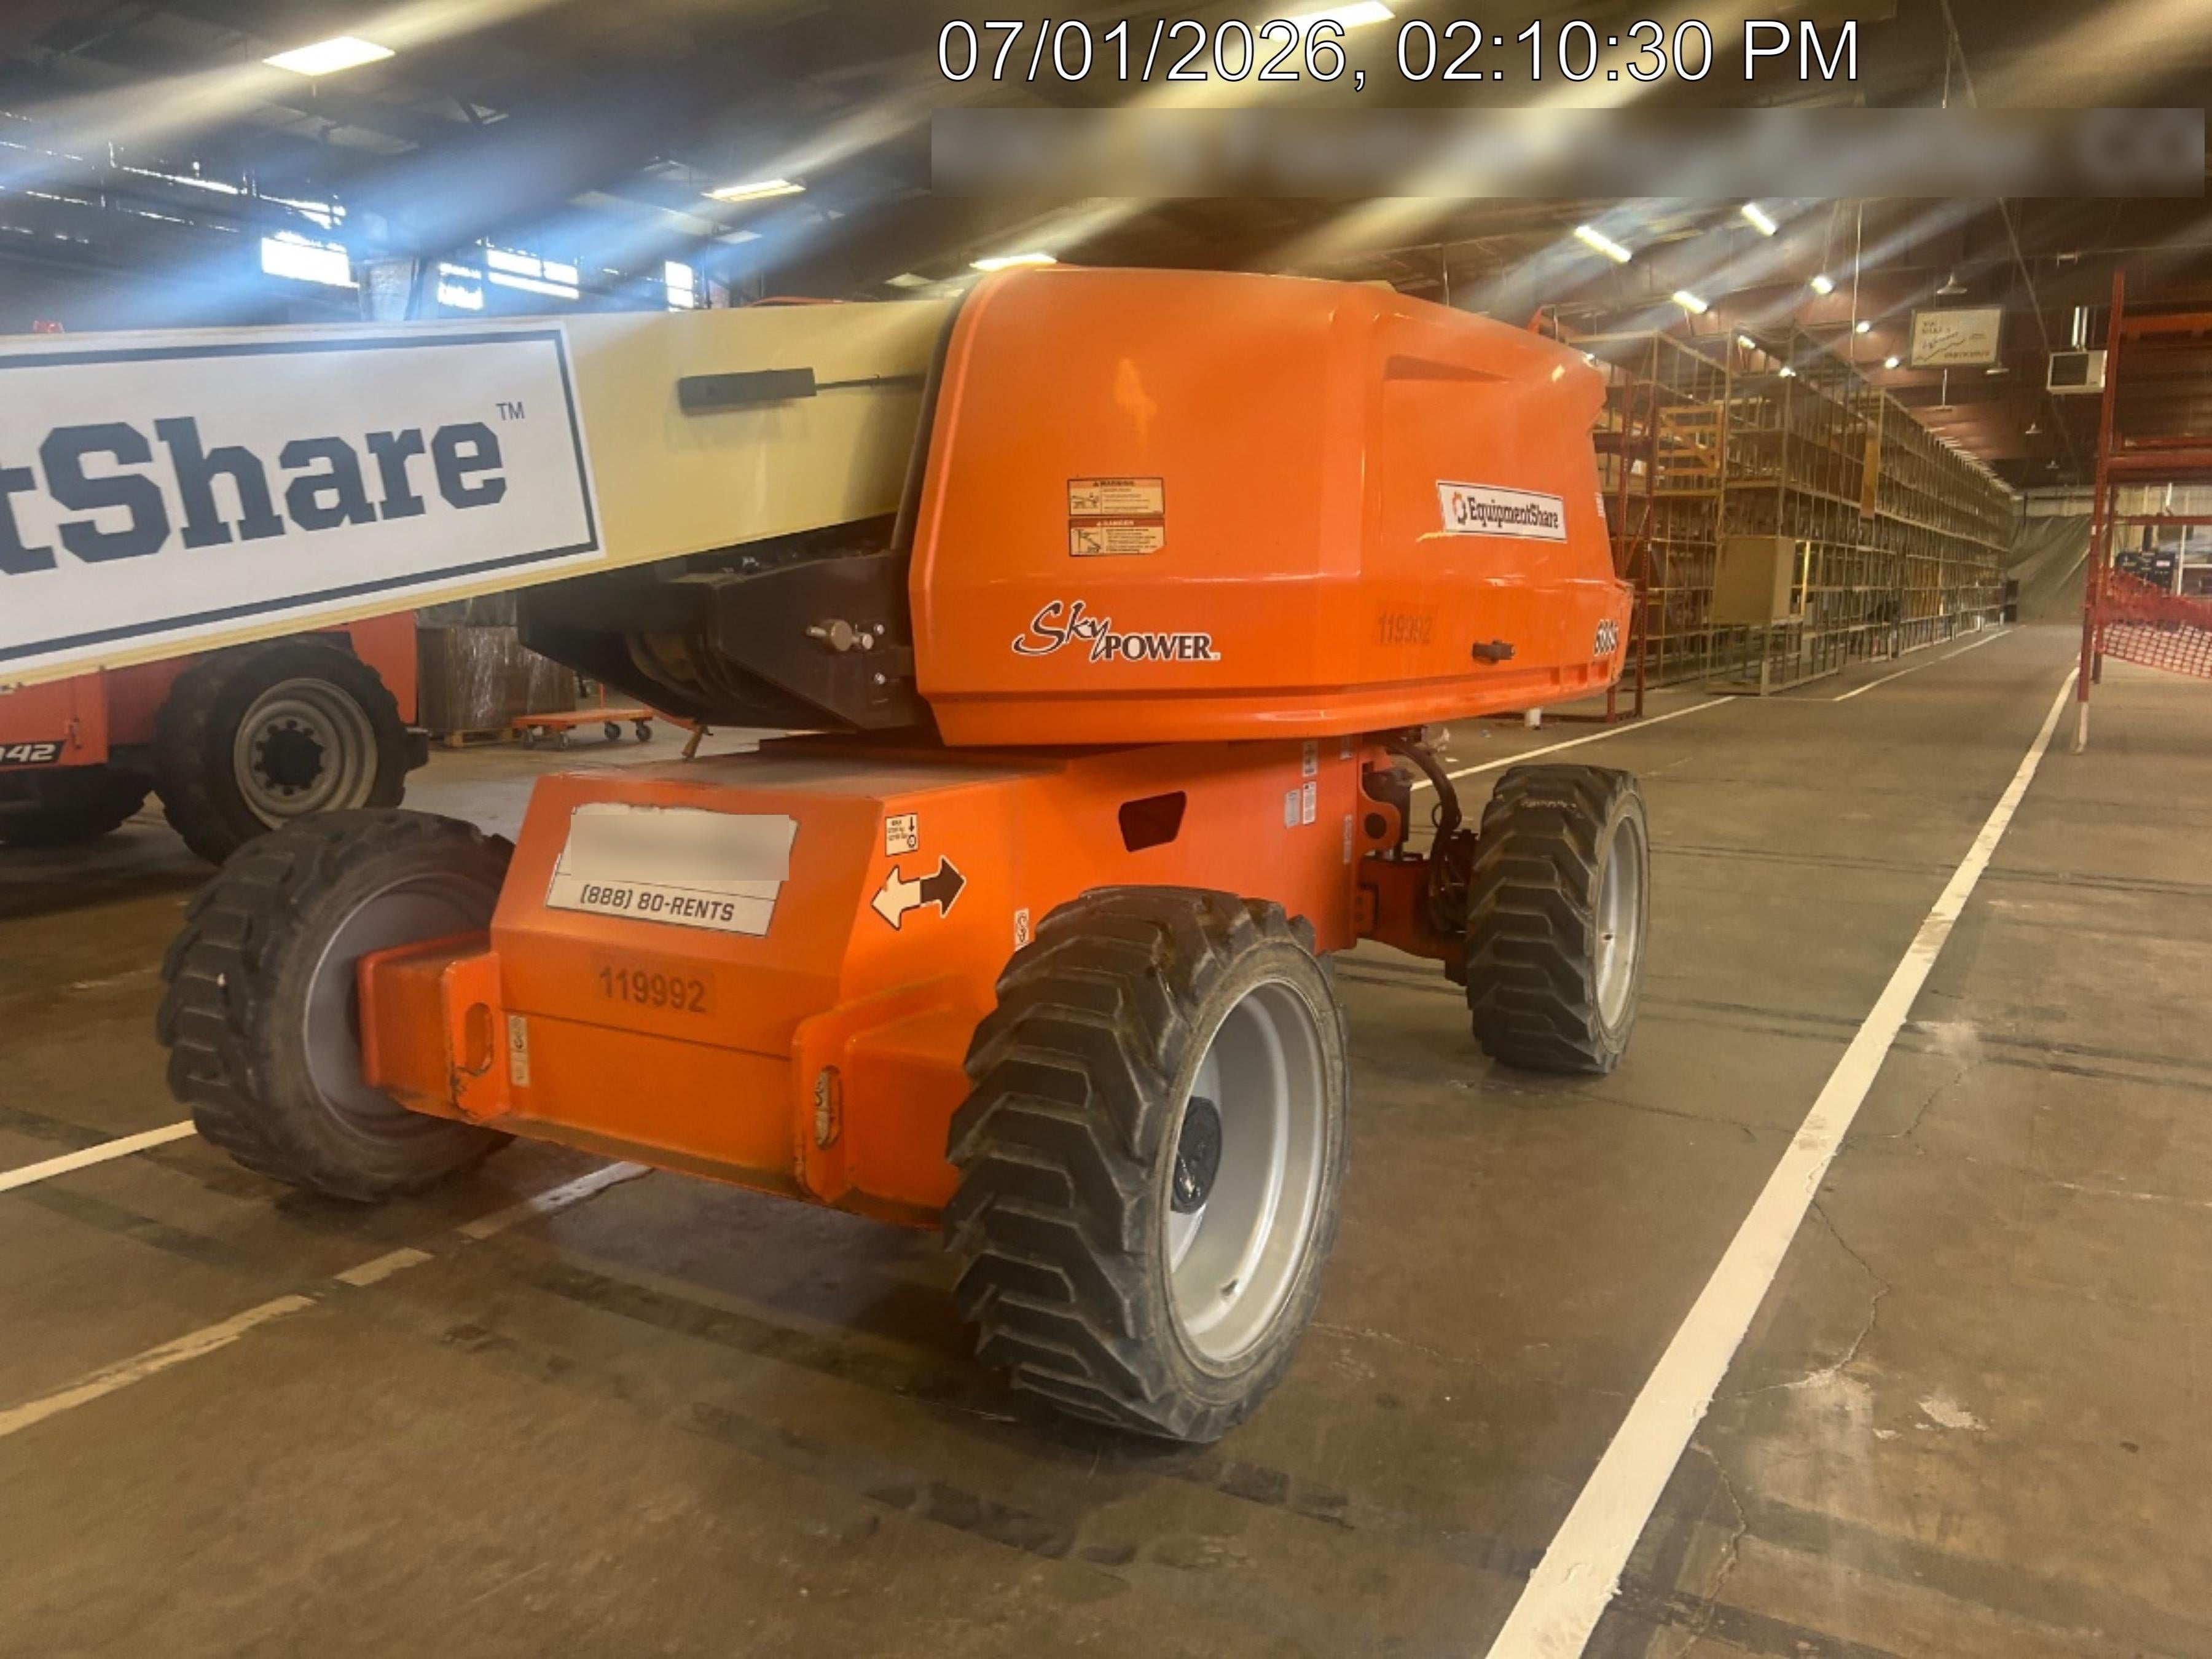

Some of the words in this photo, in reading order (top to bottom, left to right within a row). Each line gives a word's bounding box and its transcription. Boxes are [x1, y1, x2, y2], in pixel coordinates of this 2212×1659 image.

[1467, 496, 1559, 530] EquipmentShare
[580, 884, 633, 909] (888)
[637, 892, 735, 922] 80-RENTS
[598, 965, 707, 1013] 119992
